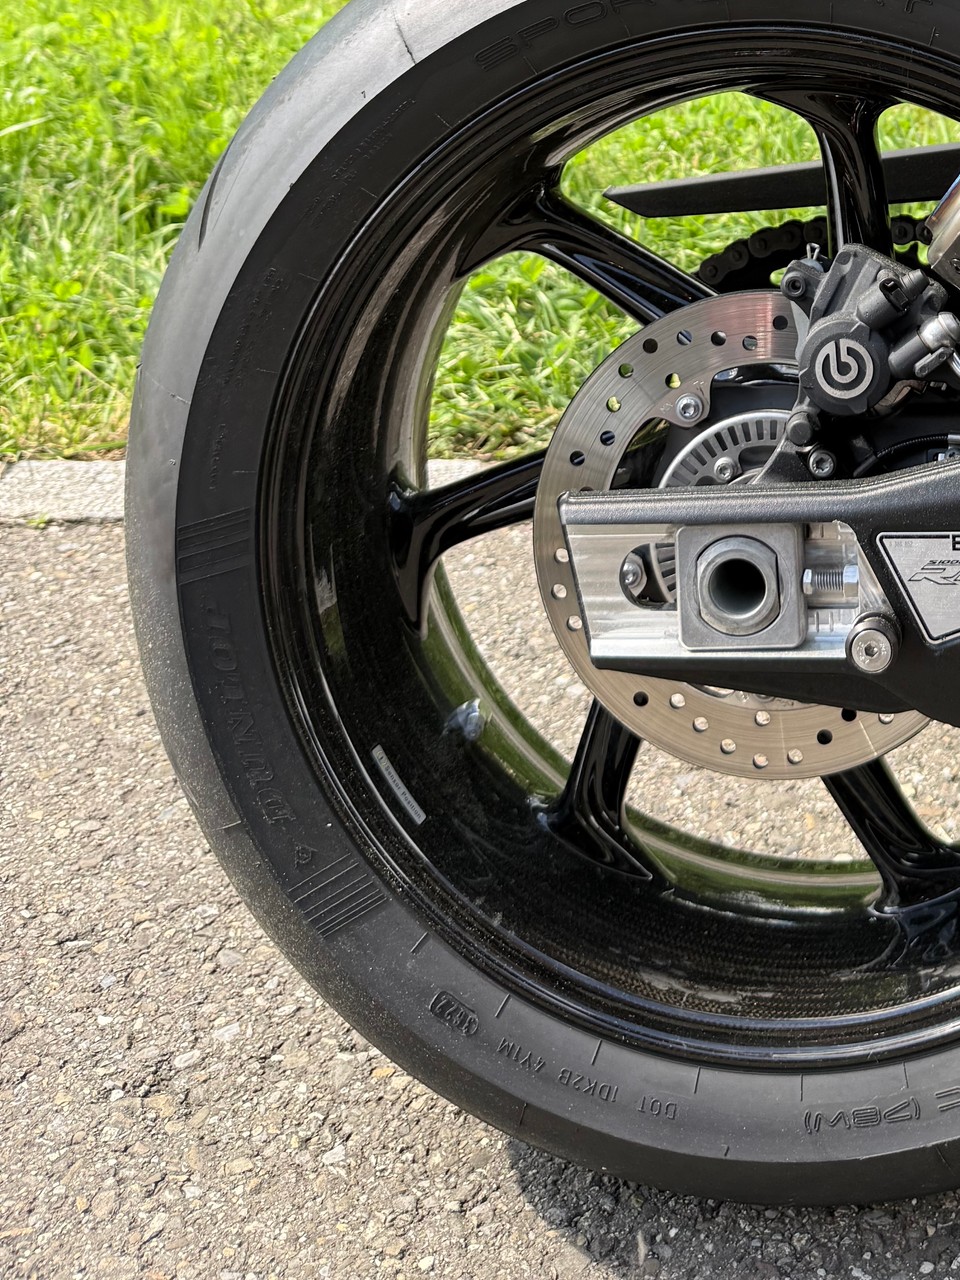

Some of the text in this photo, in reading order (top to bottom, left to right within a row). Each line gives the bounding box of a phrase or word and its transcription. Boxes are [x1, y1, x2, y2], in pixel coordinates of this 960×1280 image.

[384, 763, 422, 820] Sensor Position
[496, 1036, 546, 1071] 4Y1M
[557, 1066, 620, 1103] 1DK2B
[637, 1093, 679, 1121] DOT
